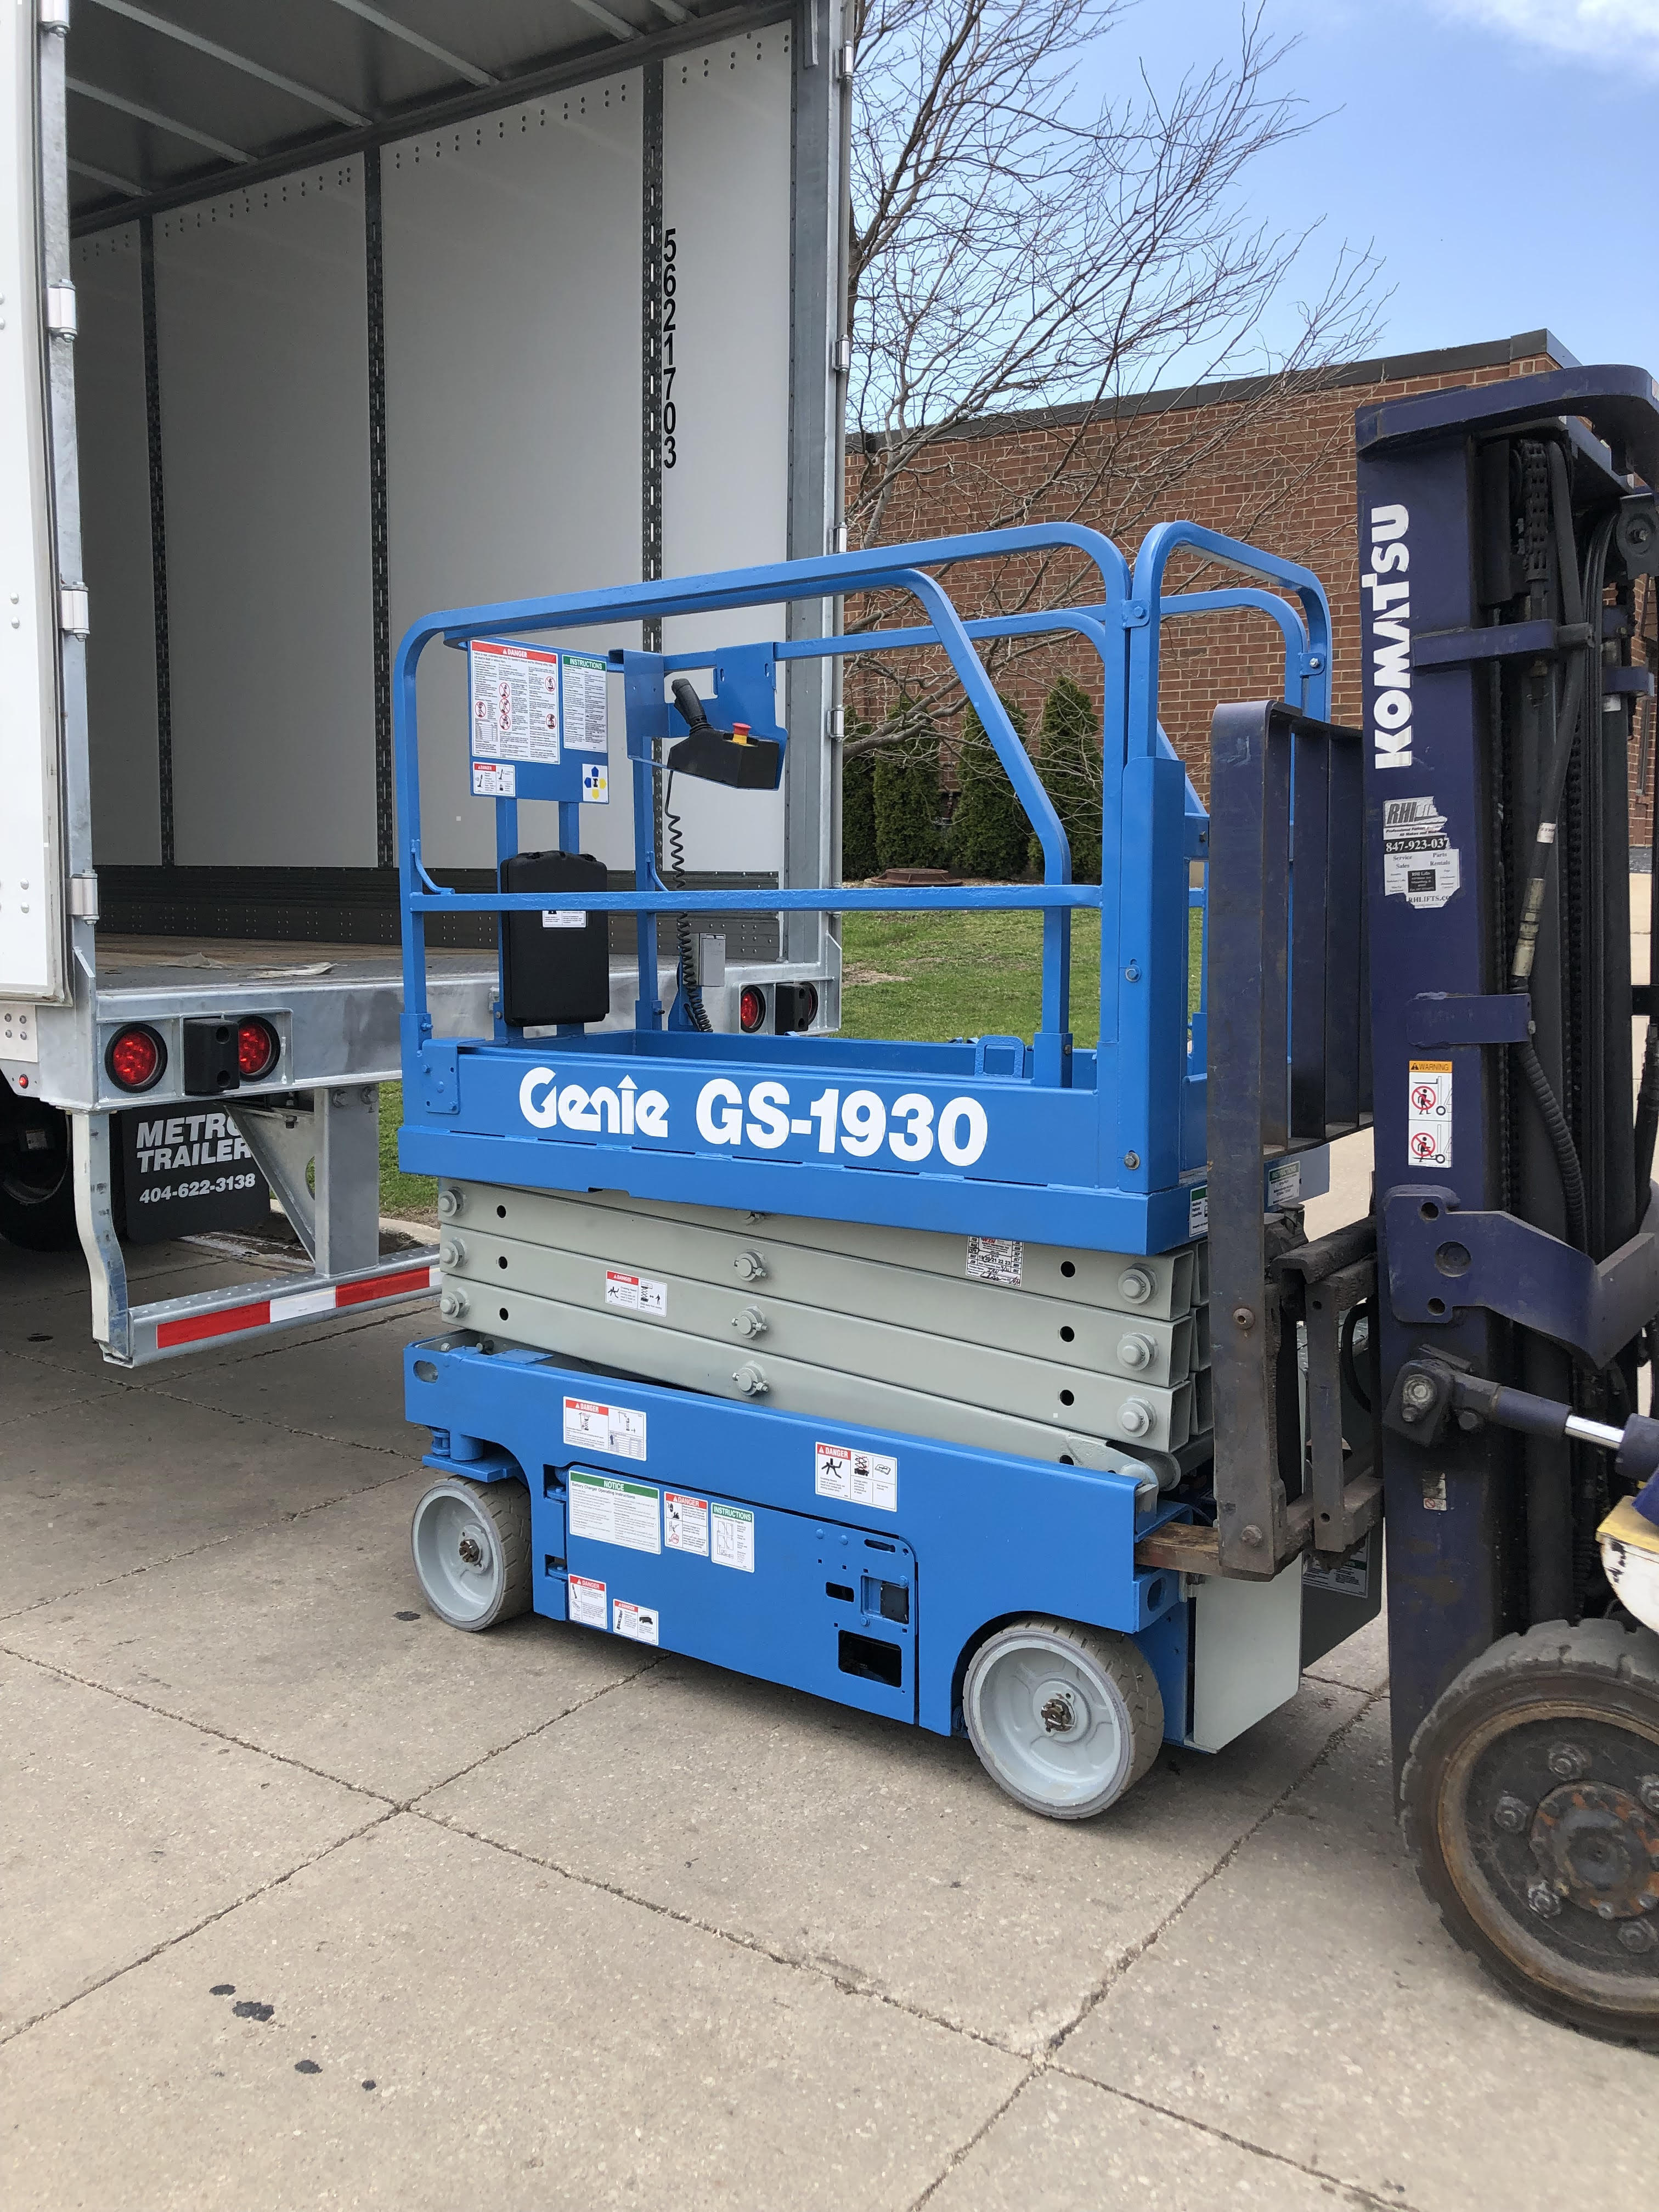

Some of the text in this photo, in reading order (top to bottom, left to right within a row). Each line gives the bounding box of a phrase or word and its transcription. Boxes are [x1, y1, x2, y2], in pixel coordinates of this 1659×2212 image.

[663, 228, 677, 469] 5621703
[1362, 504, 1413, 769] KOMATSU
[507, 648, 527, 658] DANGER
[569, 658, 602, 670] INSTRUCTIONS
[519, 1066, 988, 1167] Genie GS-1930
[137, 1137, 251, 1173] TRAILER
[139, 1173, 256, 1204] 404-622-3138
[580, 1403, 599, 1413] DANGER
[825, 1447, 848, 1459] DANGER
[603, 1480, 624, 1491] NOTICE
[678, 1497, 699, 1507] DANGER
[714, 1505, 751, 1521] INSTRUCTIONS
[582, 1580, 600, 1590] DANGER
[621, 1603, 635, 1611] DANGER
